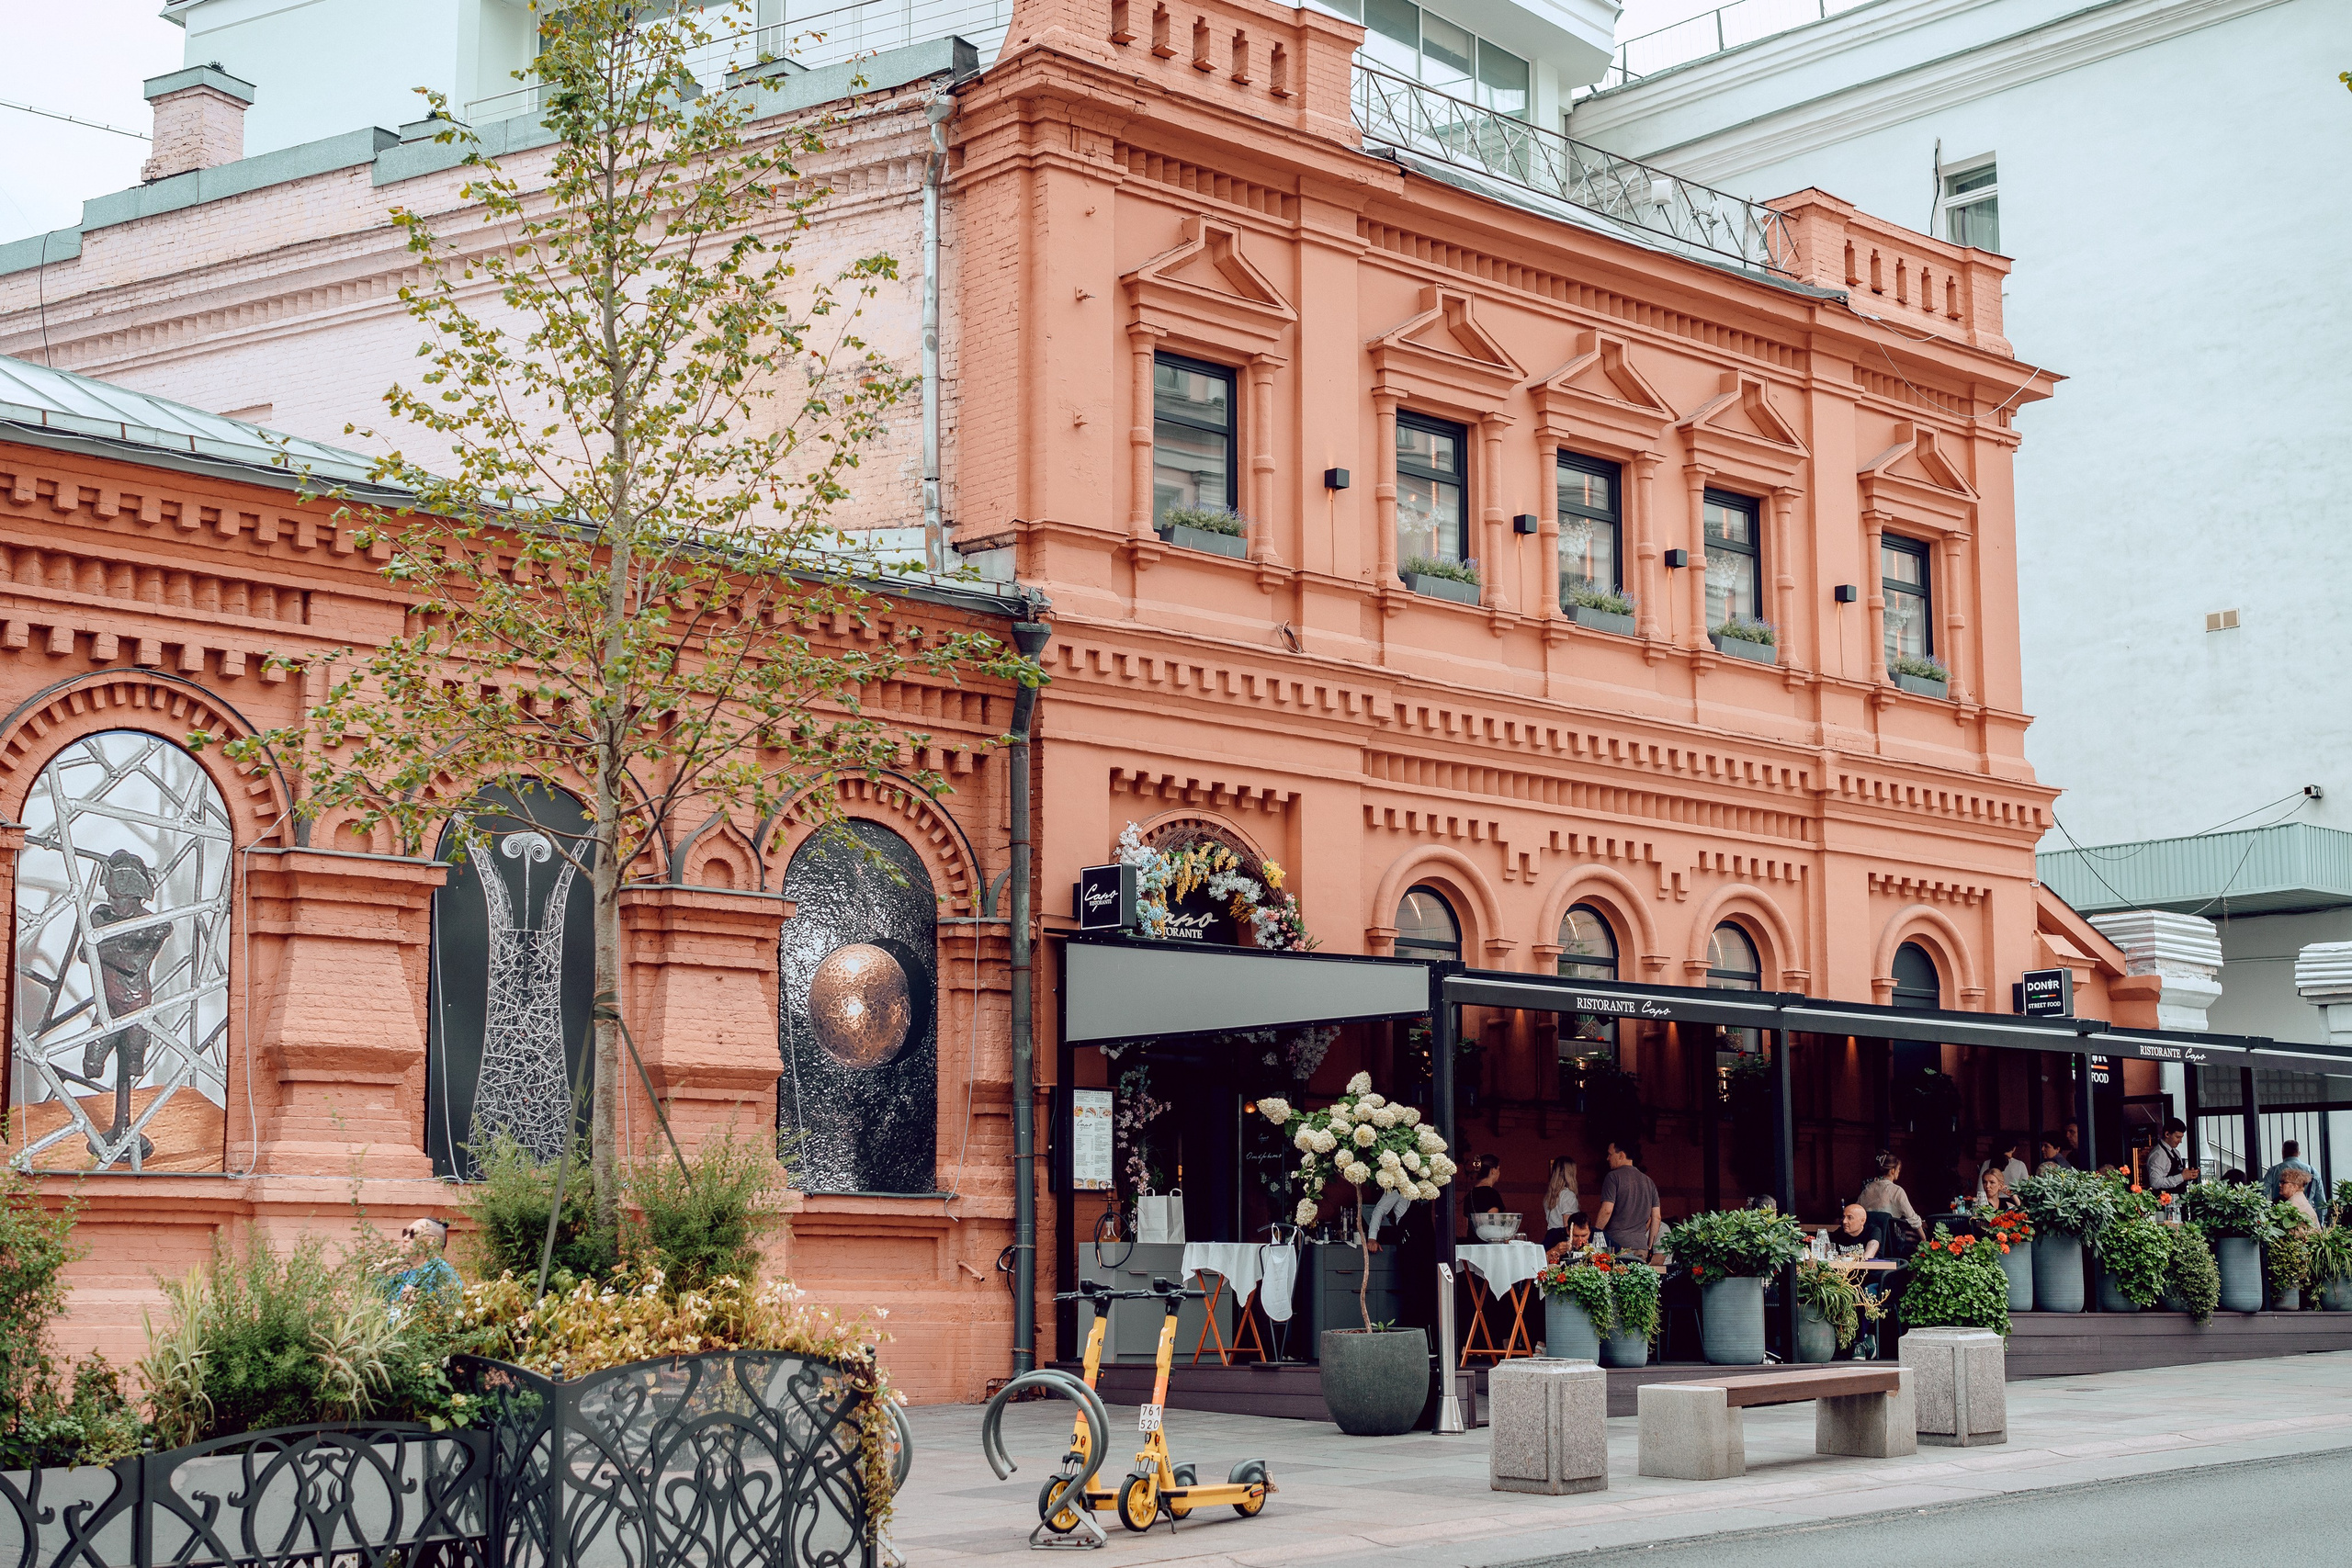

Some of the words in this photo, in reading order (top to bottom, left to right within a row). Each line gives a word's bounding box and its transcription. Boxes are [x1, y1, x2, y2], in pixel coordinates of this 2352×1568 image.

[1084, 883, 1119, 913] Capo
[1576, 997, 1635, 1013] RISTORANTE
[1641, 1000, 1671, 1017] Capo
[2139, 1045, 2181, 1058] RISTORANTE
[2184, 1047, 2207, 1062] Capo
[2090, 1071, 2109, 1084] FOOD
[1142, 1405, 1160, 1416] 761
[1140, 1419, 1159, 1430] 520
